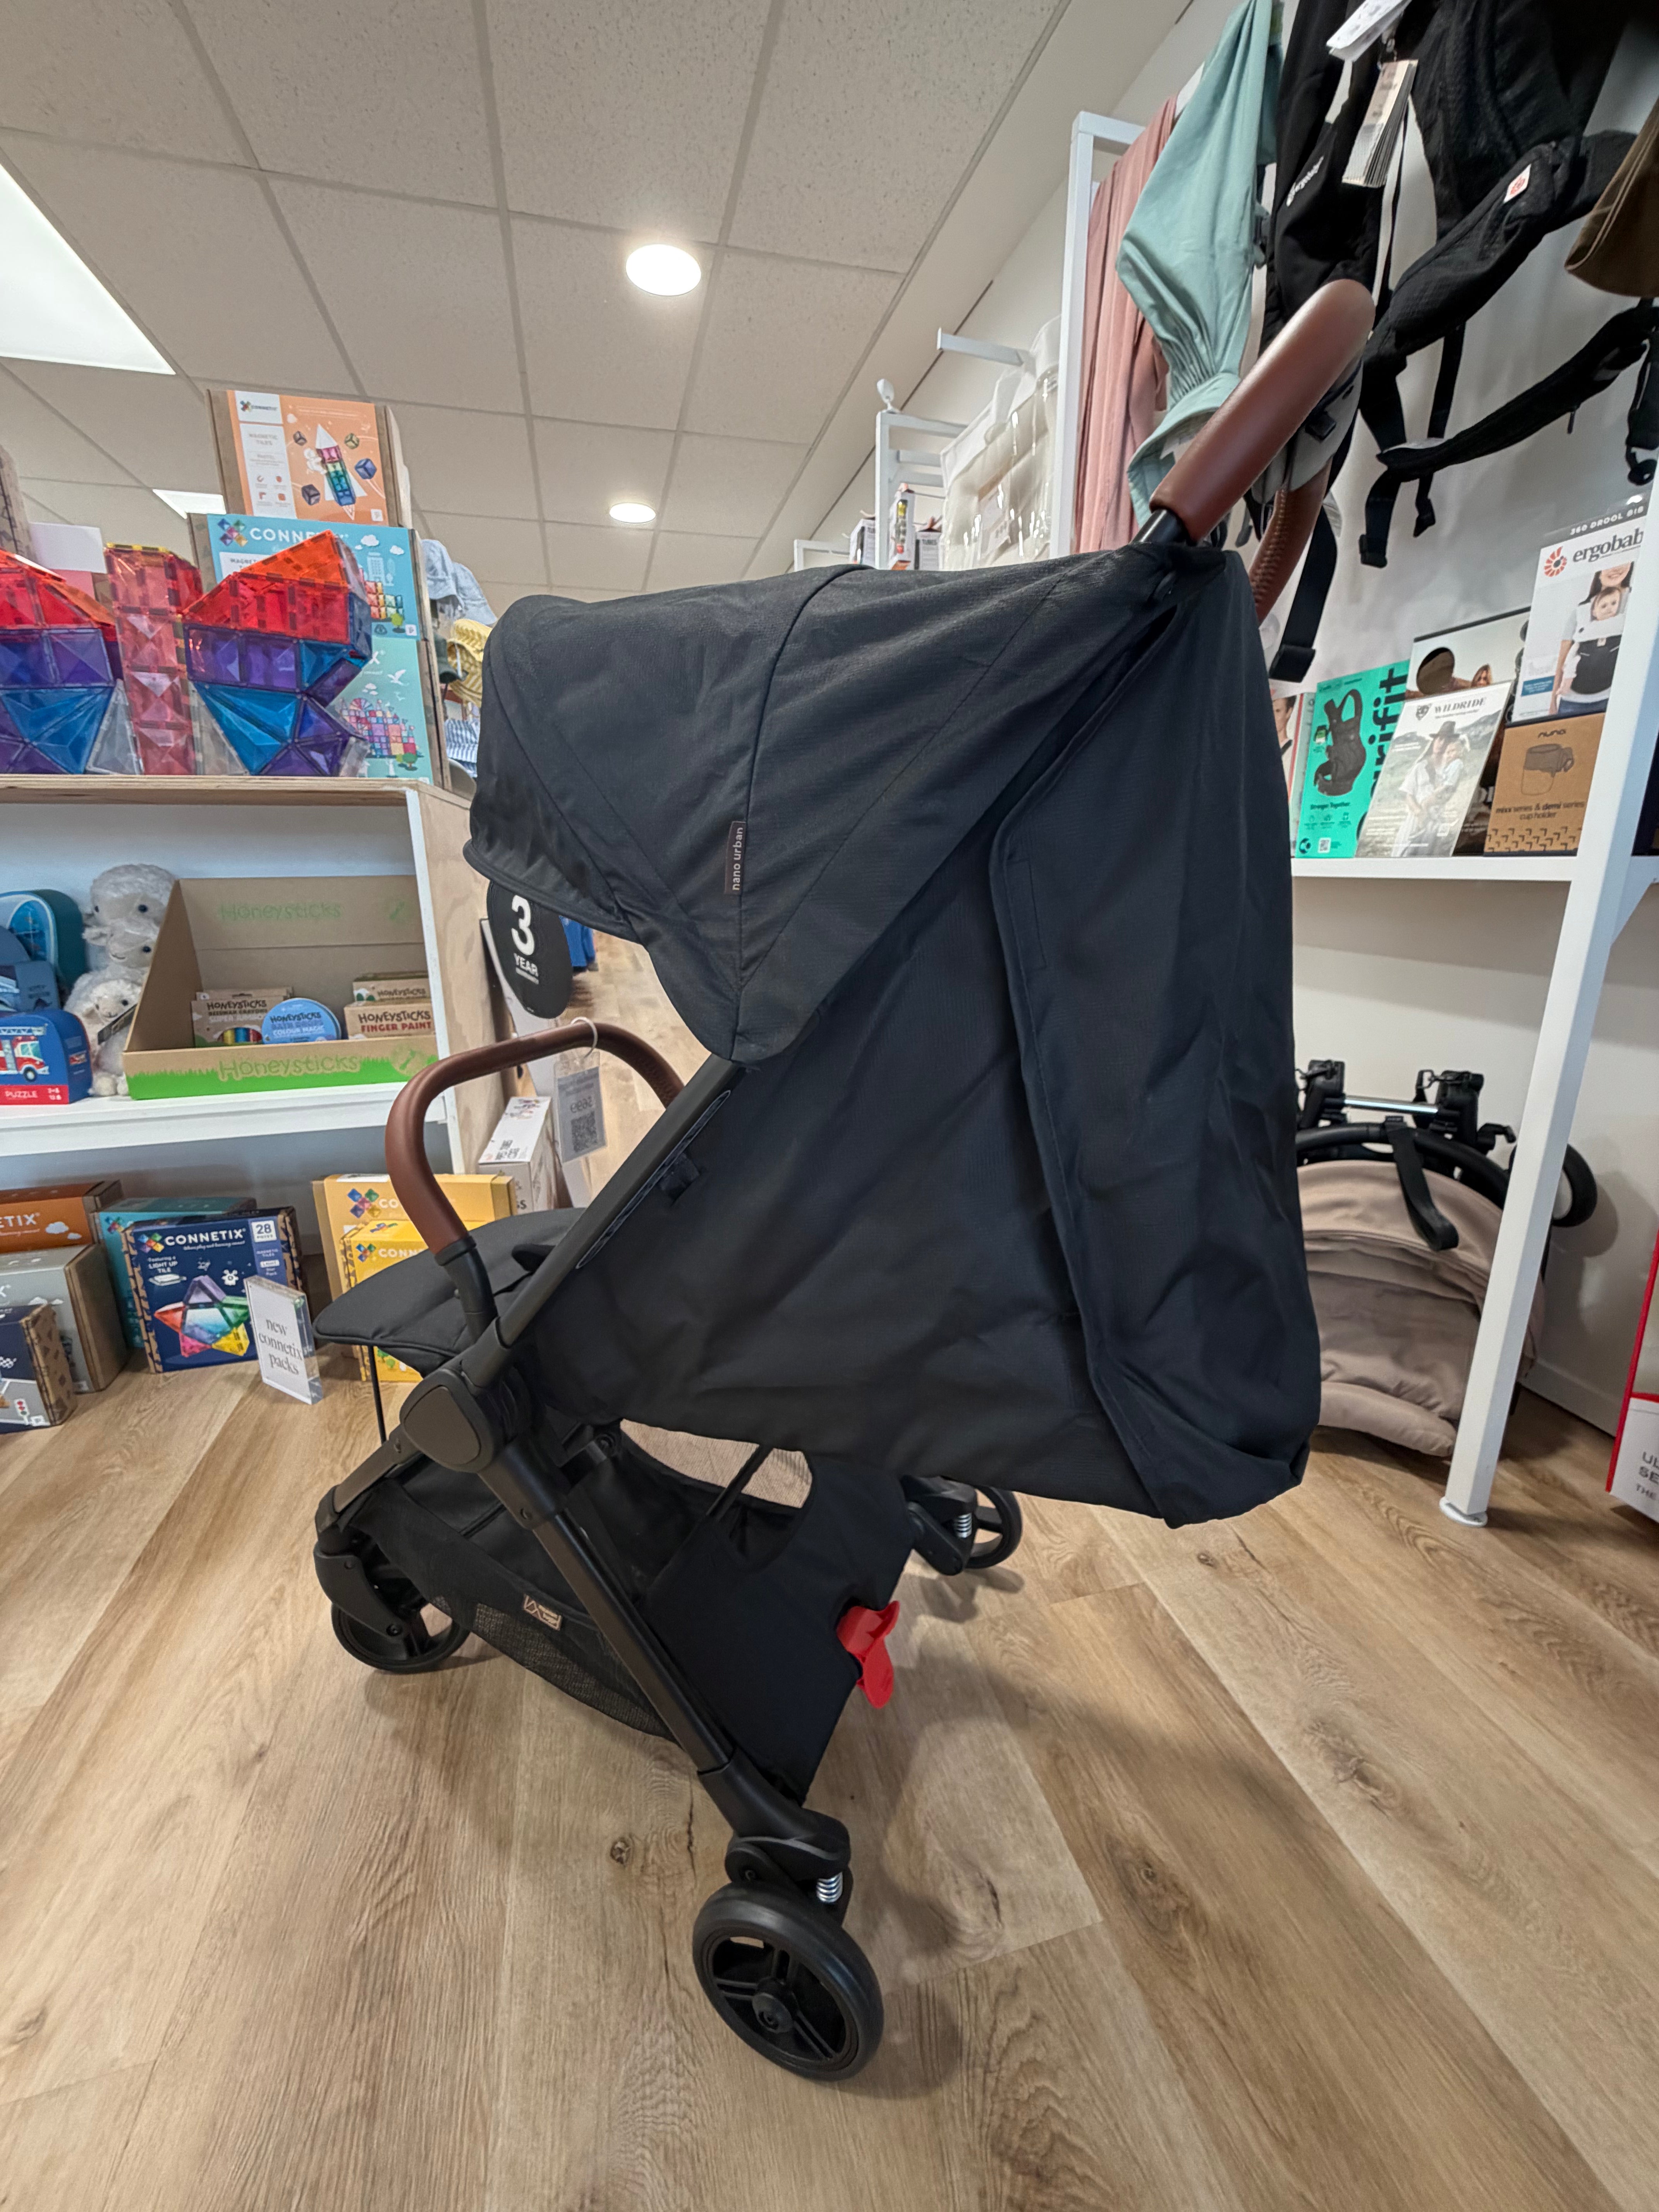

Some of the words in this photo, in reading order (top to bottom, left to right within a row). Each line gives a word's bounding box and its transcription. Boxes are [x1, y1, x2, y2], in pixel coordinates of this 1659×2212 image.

[1590, 513, 1623, 529] DROOL
[1573, 527, 1644, 562] ergobab
[1435, 697, 1487, 714] WILDRIDE
[732, 827, 744, 860] urban
[732, 863, 741, 891] nano
[511, 895, 535, 956] 3
[513, 952, 539, 977] YEAR
[207, 1000, 267, 1010] HONEYSTICKS
[270, 1012, 322, 1023] HONEYSTICKS
[359, 1010, 431, 1024] HONEYSTICKS
[361, 1024, 398, 1033] FINGER
[401, 1021, 432, 1030] PAINT
[218, 1054, 357, 1079] Honeysticks
[165, 1228, 244, 1246] CONNETIX
[256, 1223, 272, 1235] 28
[266, 1319, 288, 1336] new
[258, 1333, 303, 1361] connetix
[269, 1353, 299, 1376] packs
